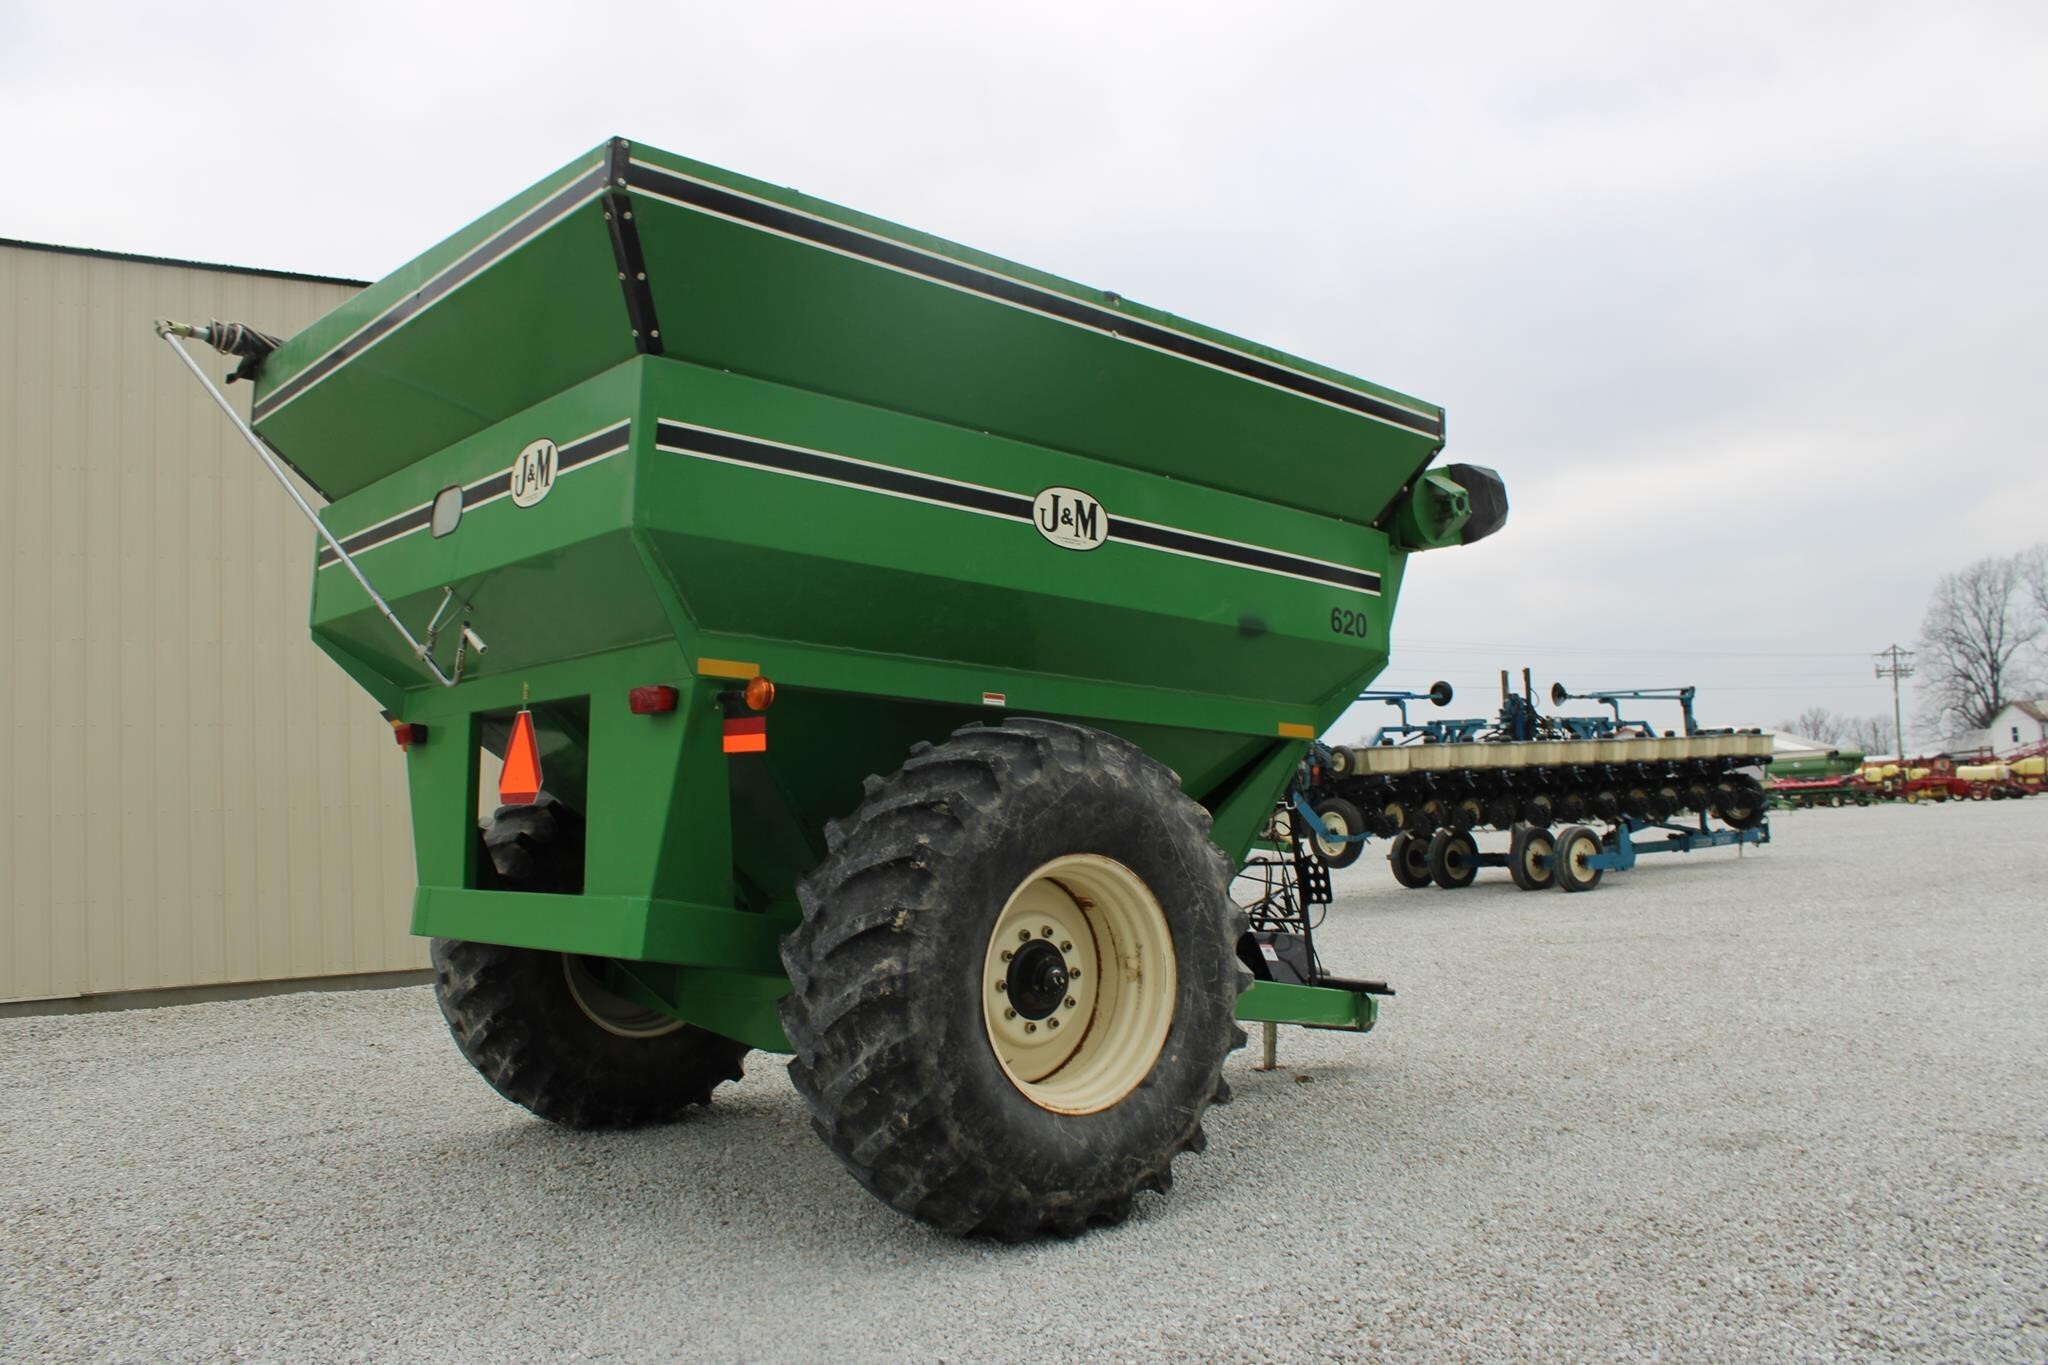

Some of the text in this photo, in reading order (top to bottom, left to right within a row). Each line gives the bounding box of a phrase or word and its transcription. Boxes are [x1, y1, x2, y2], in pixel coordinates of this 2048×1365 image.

[515, 445, 552, 497] J&M
[1040, 494, 1098, 541] J&M
[1331, 607, 1367, 638] 620
